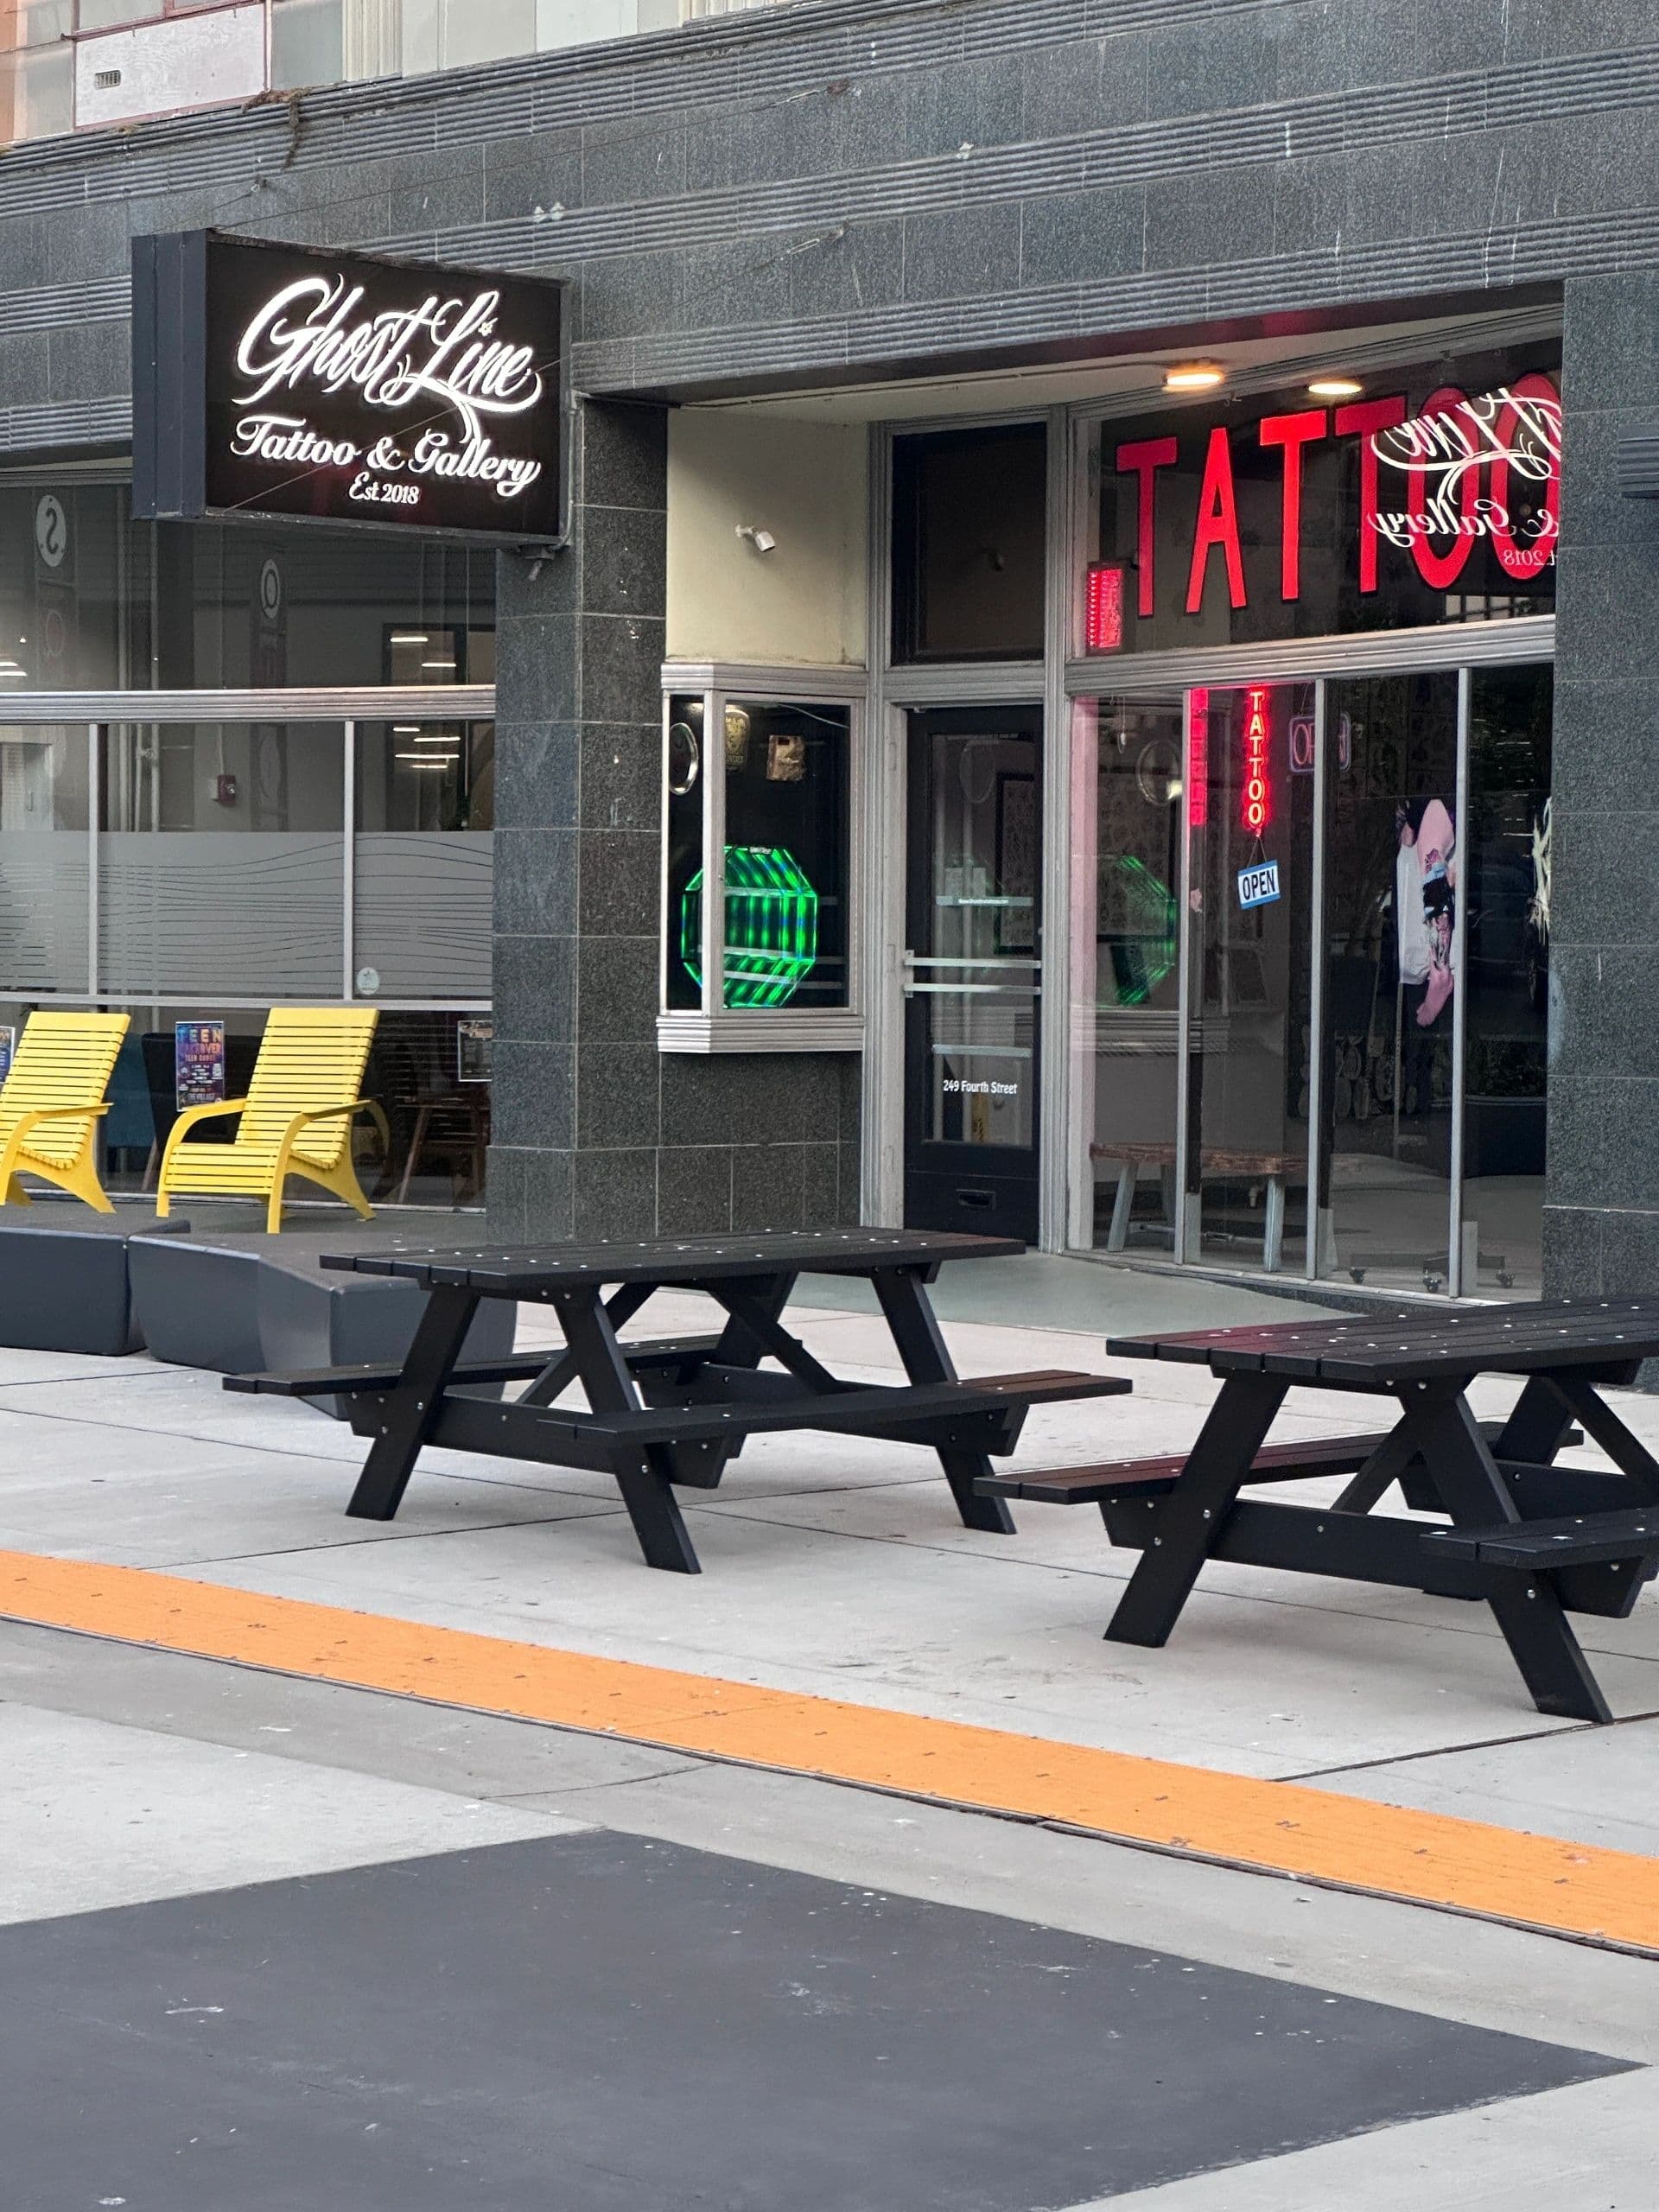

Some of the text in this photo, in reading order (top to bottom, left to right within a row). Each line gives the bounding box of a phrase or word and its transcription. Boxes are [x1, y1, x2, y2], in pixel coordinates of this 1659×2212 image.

[231, 272, 543, 413] Ghost Line
[230, 415, 542, 498] Tattoo & Gallery
[383, 483, 419, 505] 2018
[1116, 373, 1562, 617] TATTOO
[1248, 691, 1264, 824] TATTOO
[1243, 868, 1275, 900] OPEN
[176, 1028, 221, 1043] TEEN
[943, 1079, 1018, 1095] 249 Fourth Street
